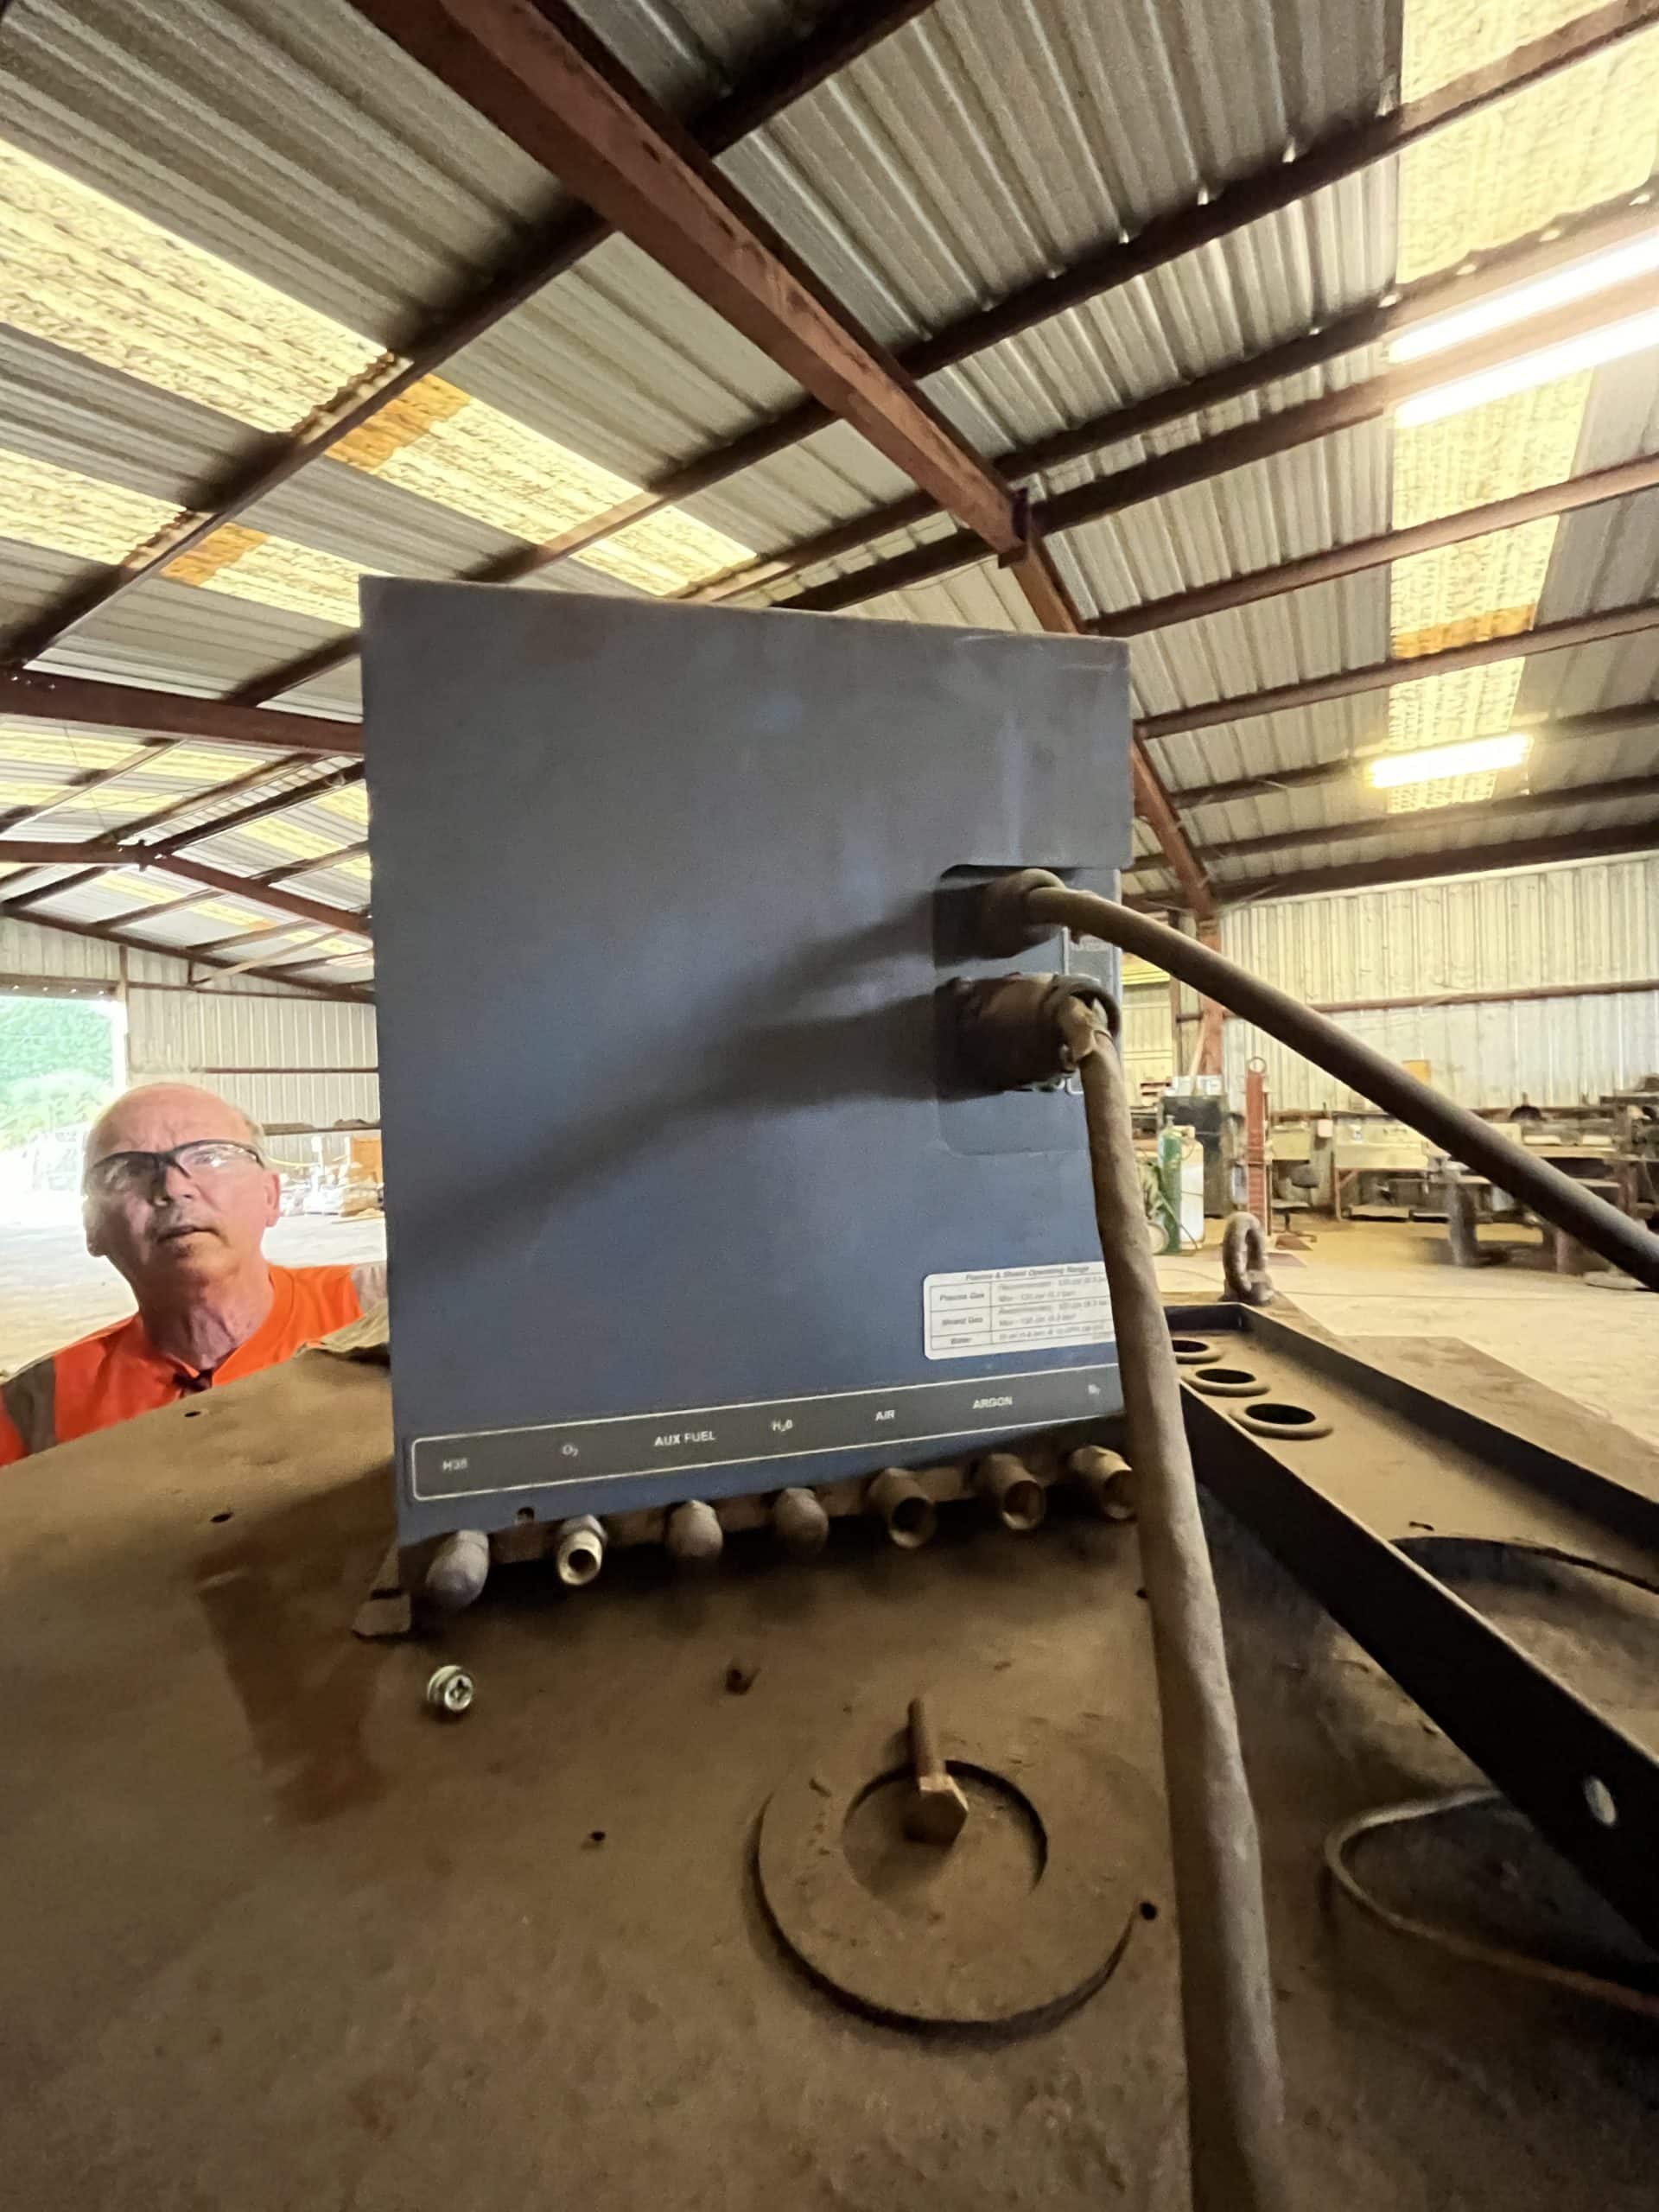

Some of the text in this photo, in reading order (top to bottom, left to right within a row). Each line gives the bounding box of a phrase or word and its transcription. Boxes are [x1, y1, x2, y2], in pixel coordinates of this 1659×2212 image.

[971, 1395, 1014, 1410] ARGON
[874, 1409, 896, 1421] AIR
[653, 1430, 717, 1447] AUX FUEL
